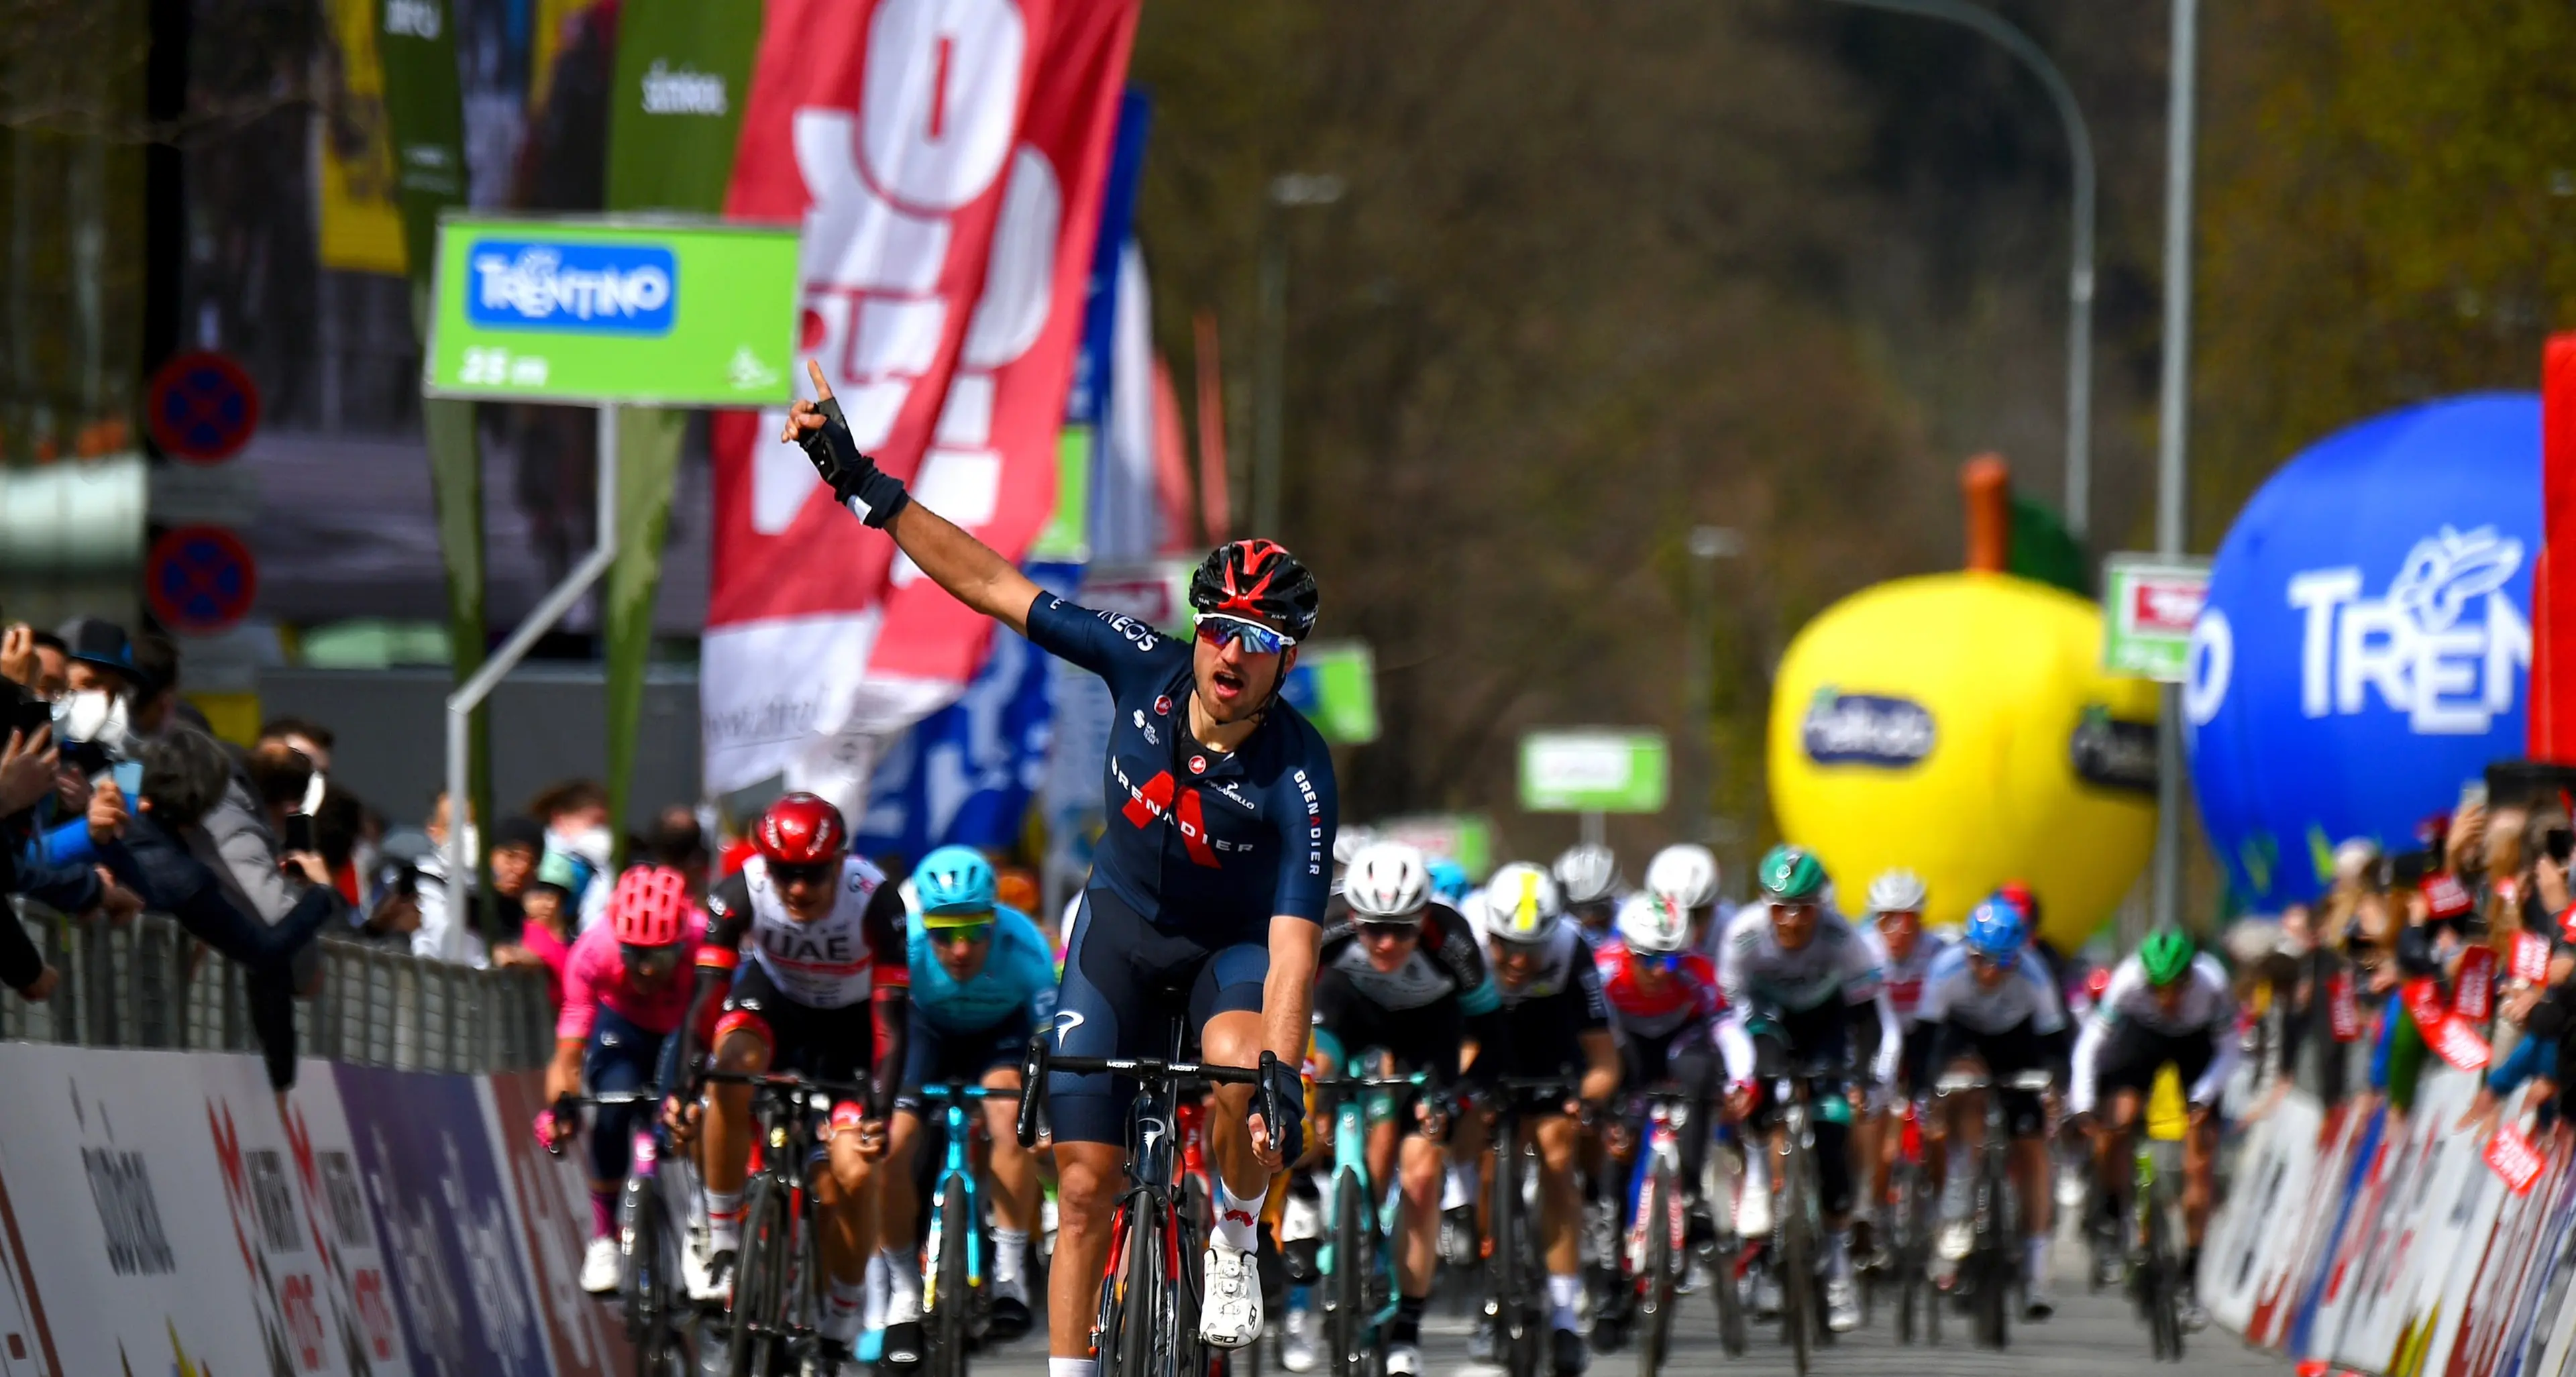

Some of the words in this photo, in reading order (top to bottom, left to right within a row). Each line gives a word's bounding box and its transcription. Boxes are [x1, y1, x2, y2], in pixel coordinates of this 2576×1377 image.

[1096, 610, 1159, 652] INEOS
[1293, 769, 1322, 875] GRENADIER
[765, 928, 853, 962] UAE
